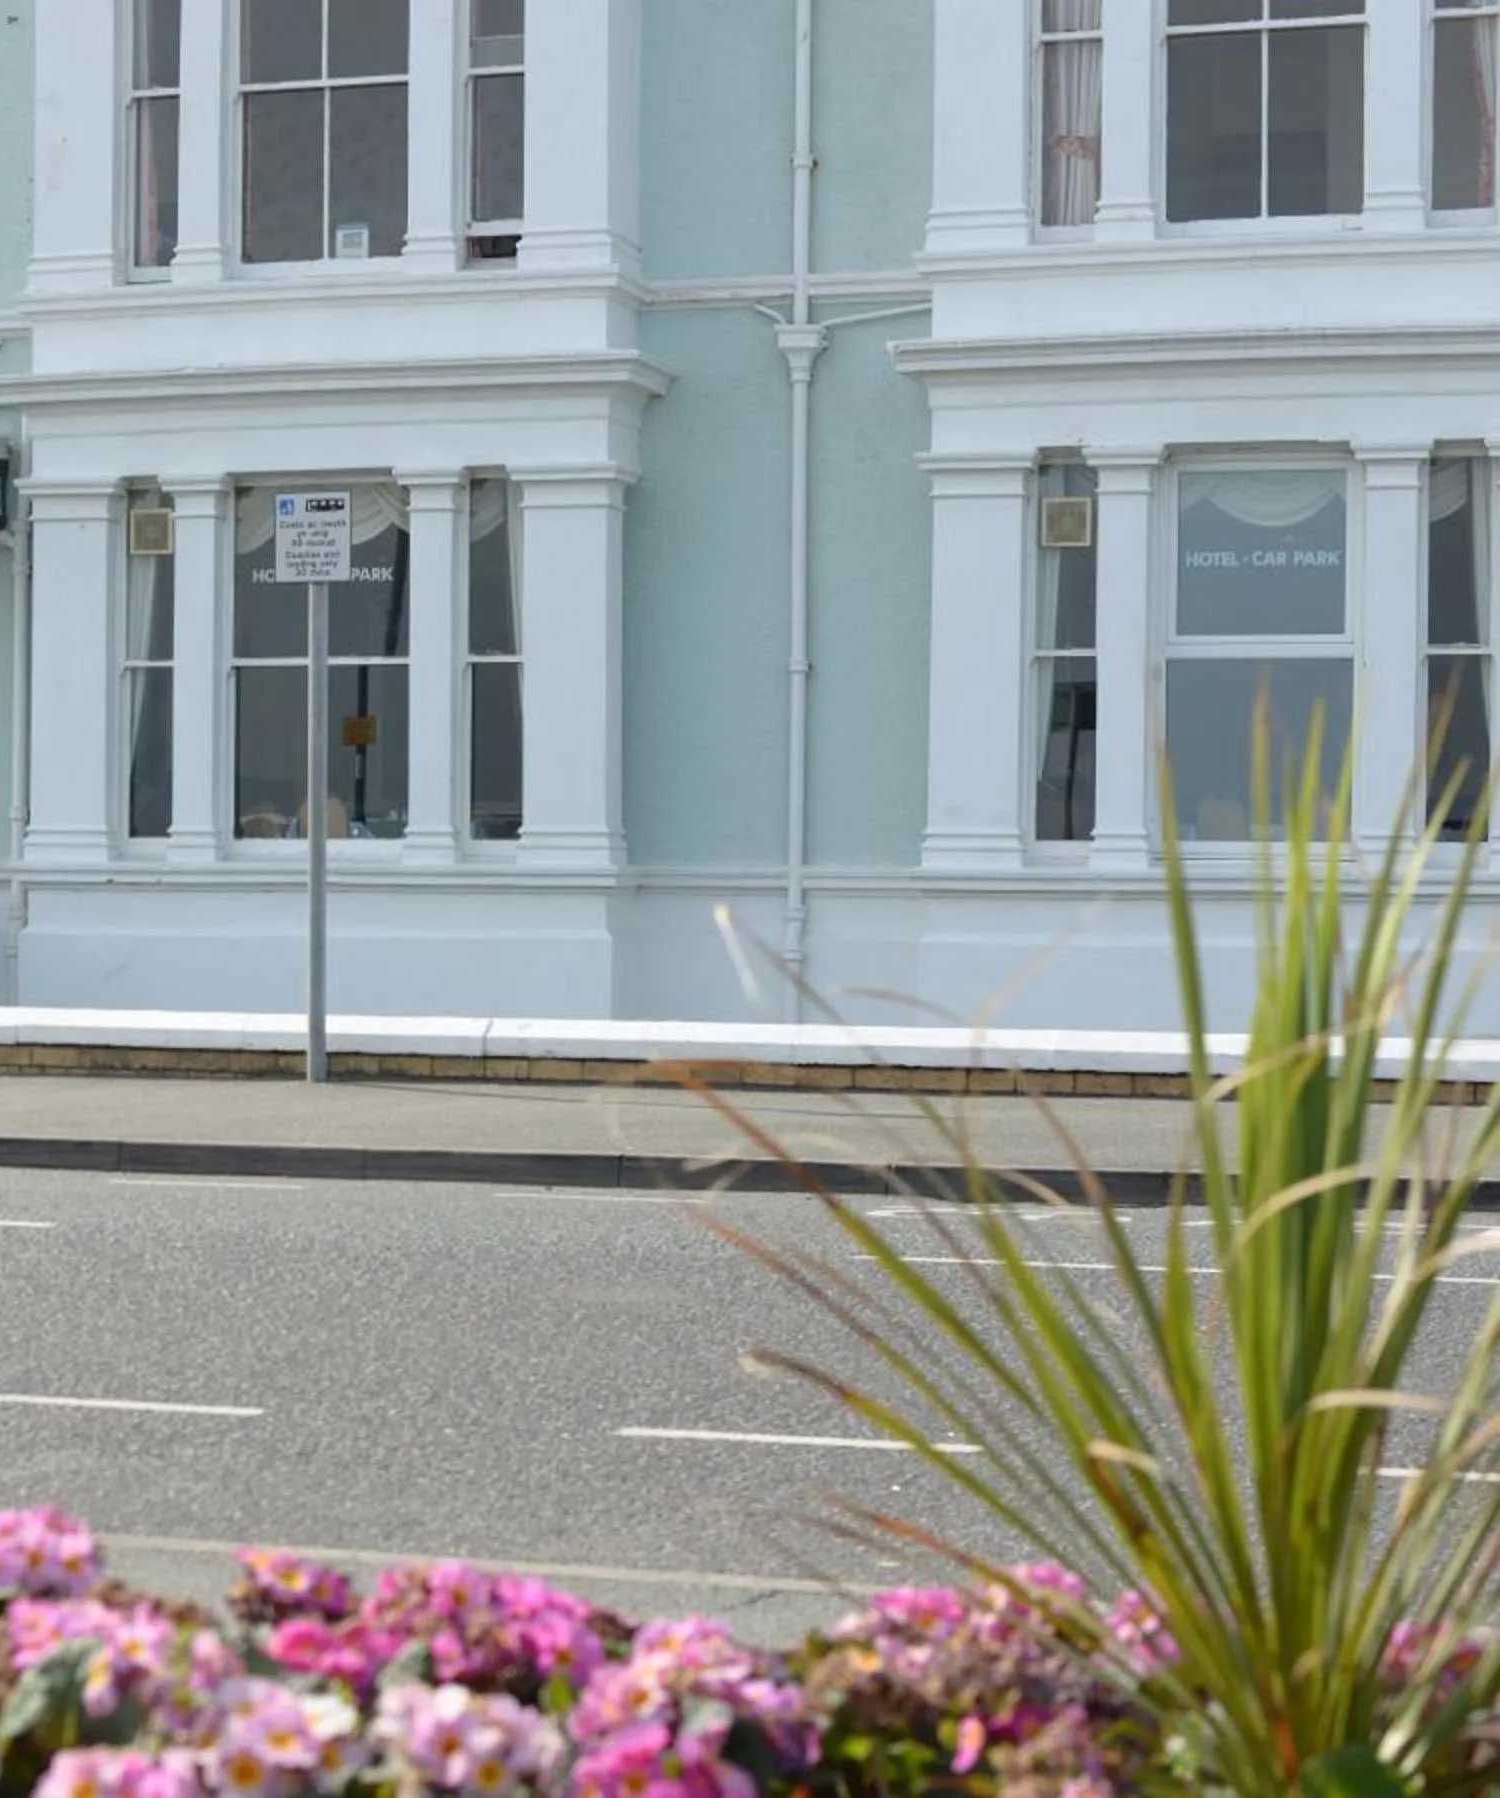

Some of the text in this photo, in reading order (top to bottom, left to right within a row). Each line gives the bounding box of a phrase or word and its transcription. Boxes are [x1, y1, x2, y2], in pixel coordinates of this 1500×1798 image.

[1185, 550, 1239, 568] HOTEL
[1252, 551, 1287, 567] CAR
[1293, 550, 1342, 567] PARK
[351, 566, 394, 582] PARK
